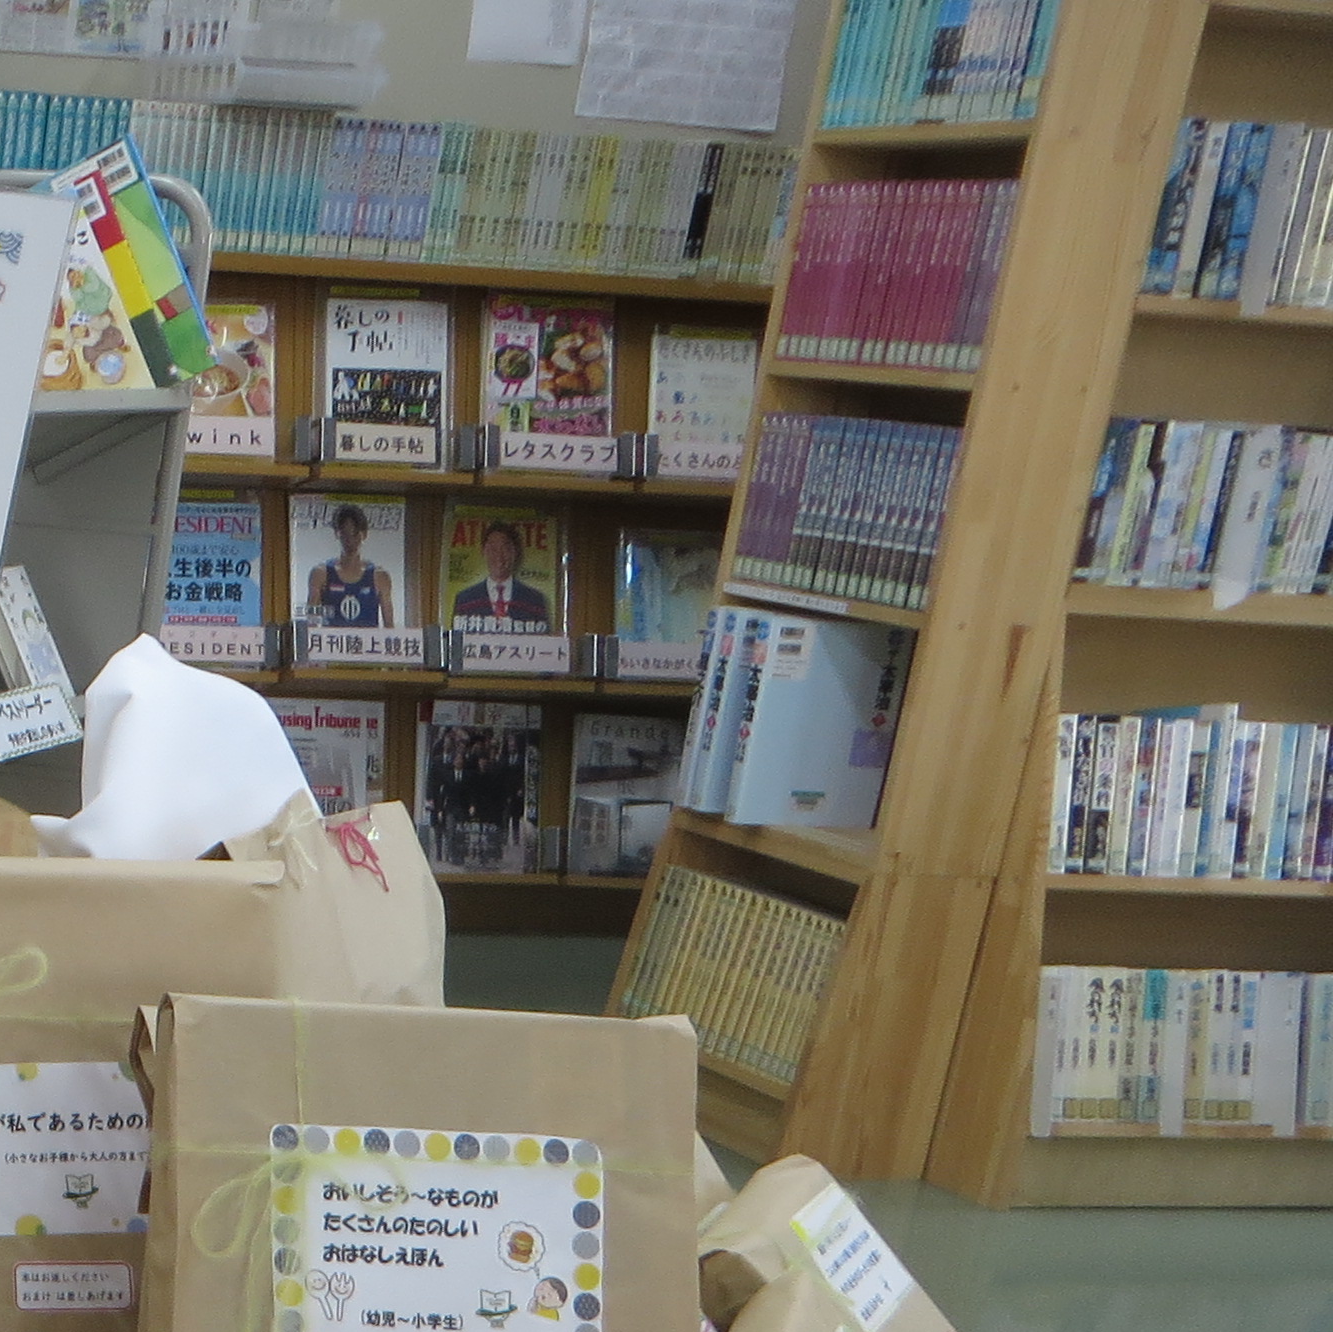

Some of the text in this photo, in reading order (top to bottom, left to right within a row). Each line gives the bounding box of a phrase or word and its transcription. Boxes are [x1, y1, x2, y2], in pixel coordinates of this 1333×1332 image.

[338, 433, 424, 455] 暮しの手帖
[503, 439, 616, 464] レタスクラブ
[173, 516, 255, 535] ESIDENT
[307, 634, 422, 657] 月刊陸上競技
[464, 643, 567, 661] 広島アスリート
[322, 1211, 479, 1238] たくさんのたのしい
[322, 1243, 445, 1268] おはなしえほん
